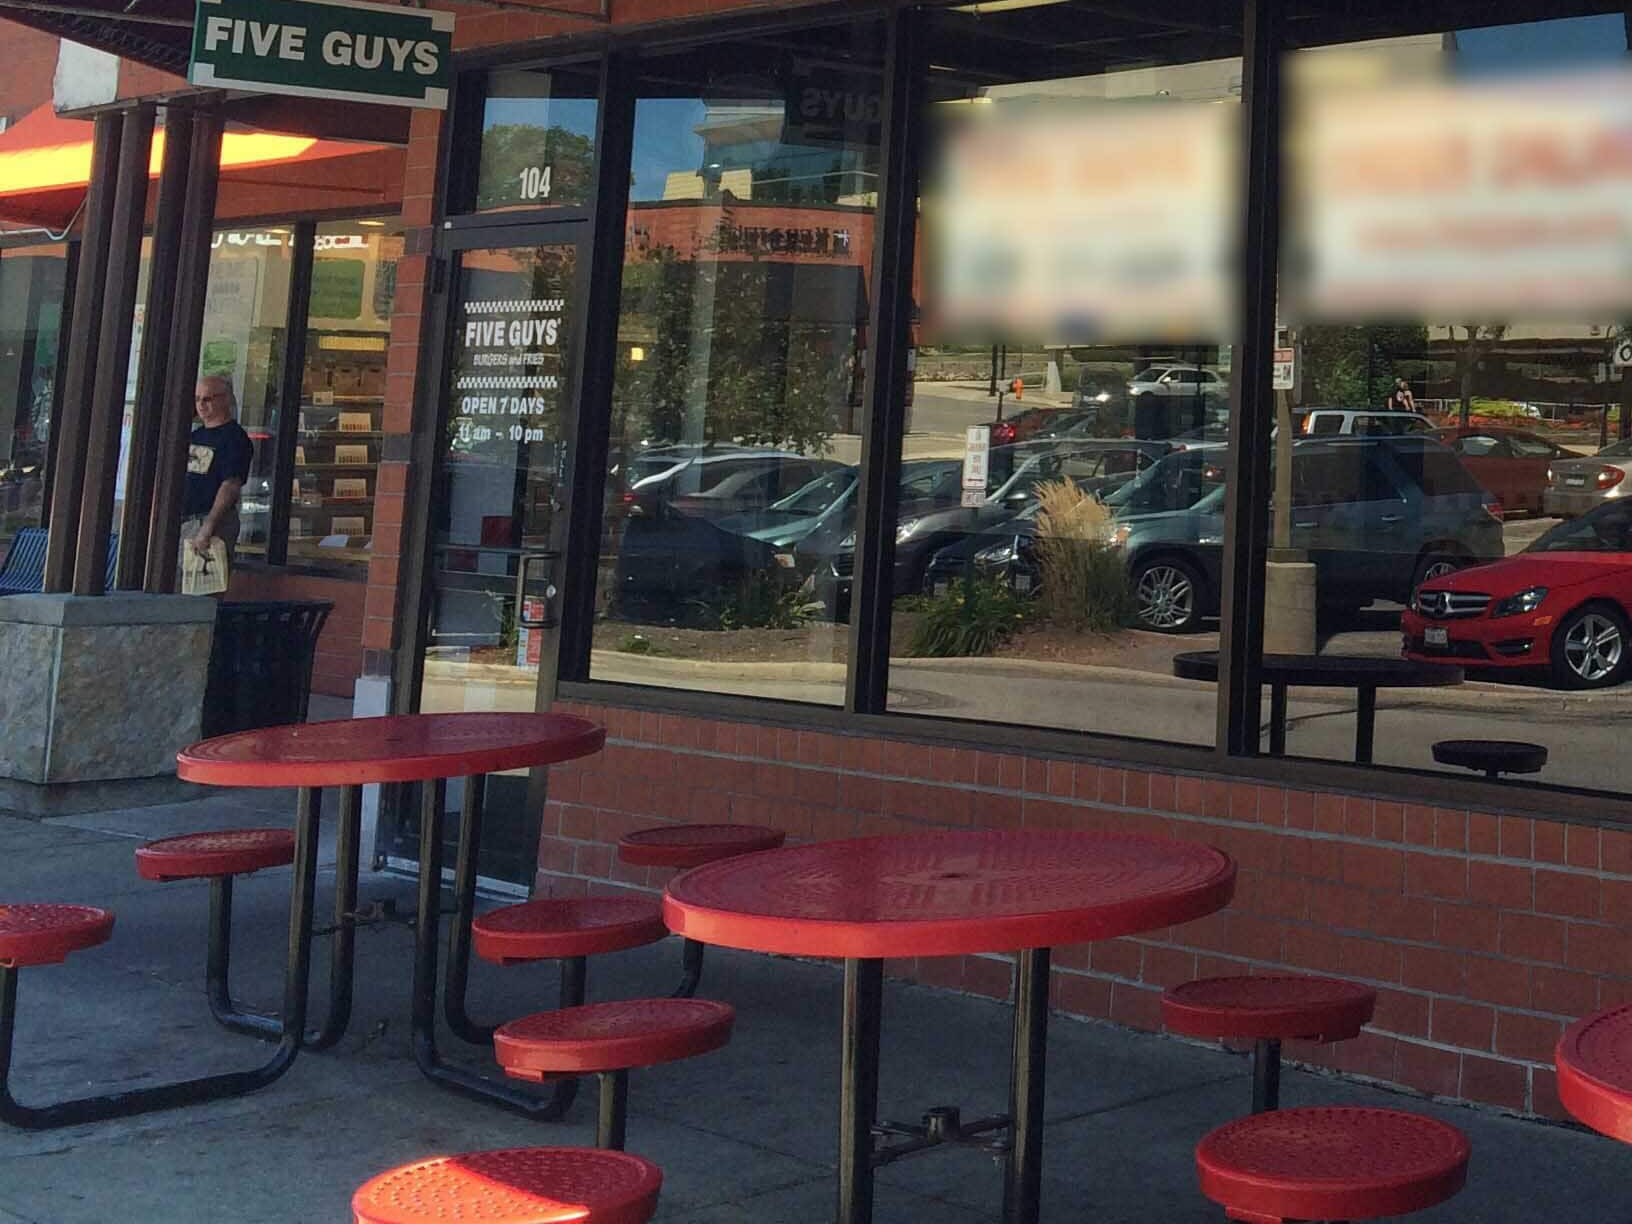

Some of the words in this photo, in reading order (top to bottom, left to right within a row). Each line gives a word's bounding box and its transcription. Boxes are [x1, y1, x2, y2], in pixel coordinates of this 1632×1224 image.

[204, 16, 307, 61] FIVE
[322, 30, 439, 75] GUYS
[519, 166, 551, 200] 104
[465, 321, 505, 348] FIVE
[473, 353, 507, 366] BURGERS
[462, 397, 496, 415] OPEN
[500, 397, 508, 414] 7
[510, 397, 545, 415] DAYS
[473, 427, 491, 440] am
[509, 425, 522, 441] 10
[524, 427, 544, 444] pm
